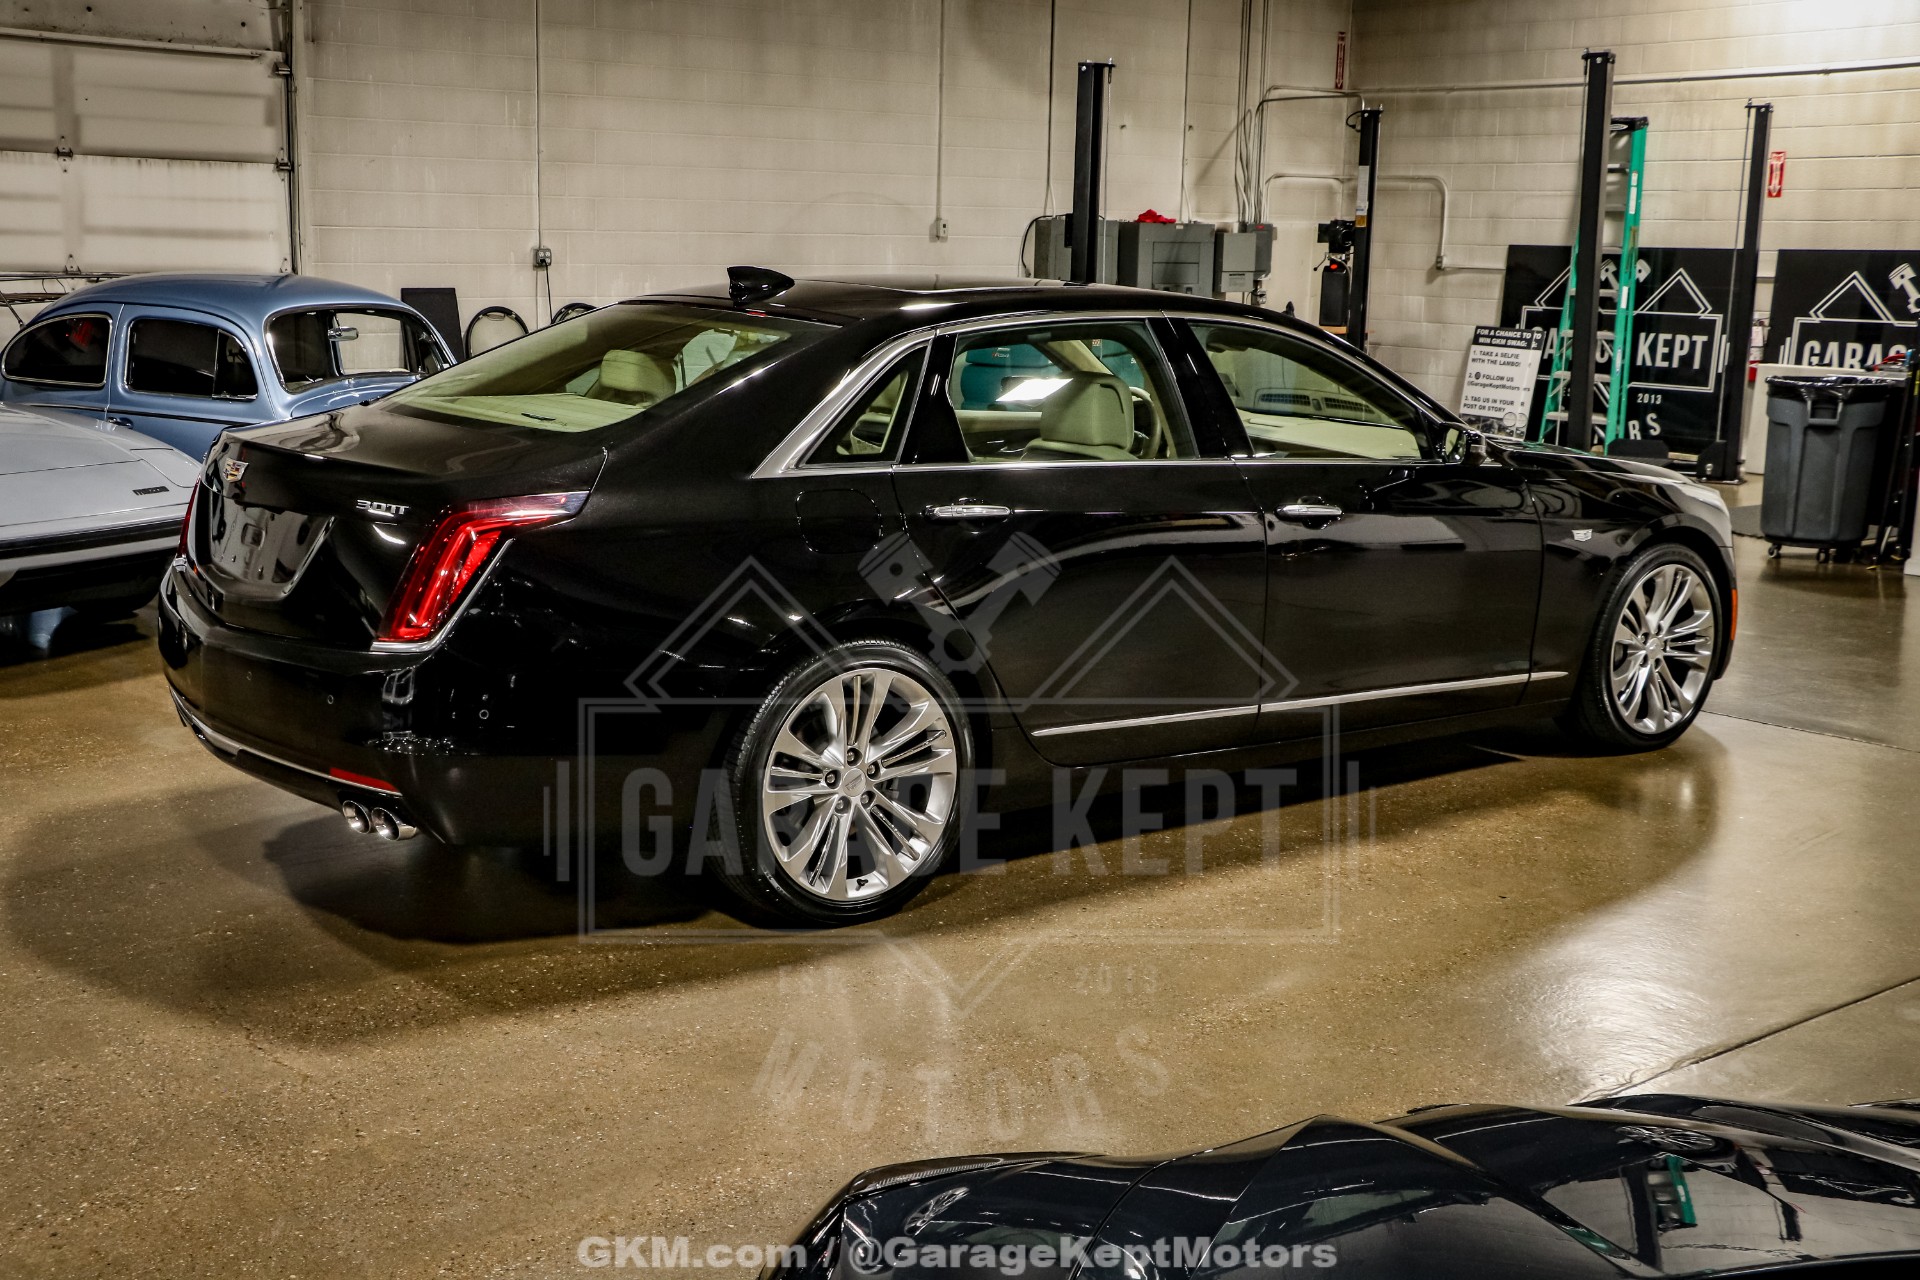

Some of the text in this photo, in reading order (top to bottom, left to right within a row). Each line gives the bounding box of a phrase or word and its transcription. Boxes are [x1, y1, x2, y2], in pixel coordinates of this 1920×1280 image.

[1476, 328, 1490, 336] FOR
[1495, 330, 1522, 338] CHANCE
[1478, 336, 1492, 344] WIN
[1491, 337, 1507, 345] GKM
[1506, 339, 1528, 347] SWAG:
[1500, 352, 1520, 360] SELFIE
[1636, 332, 1708, 370] KEPT
[1801, 340, 1908, 370] GARA
[1482, 373, 1506, 381] FOLLOW
[1637, 392, 1662, 405] 2013
[1487, 405, 1506, 413] STORY
